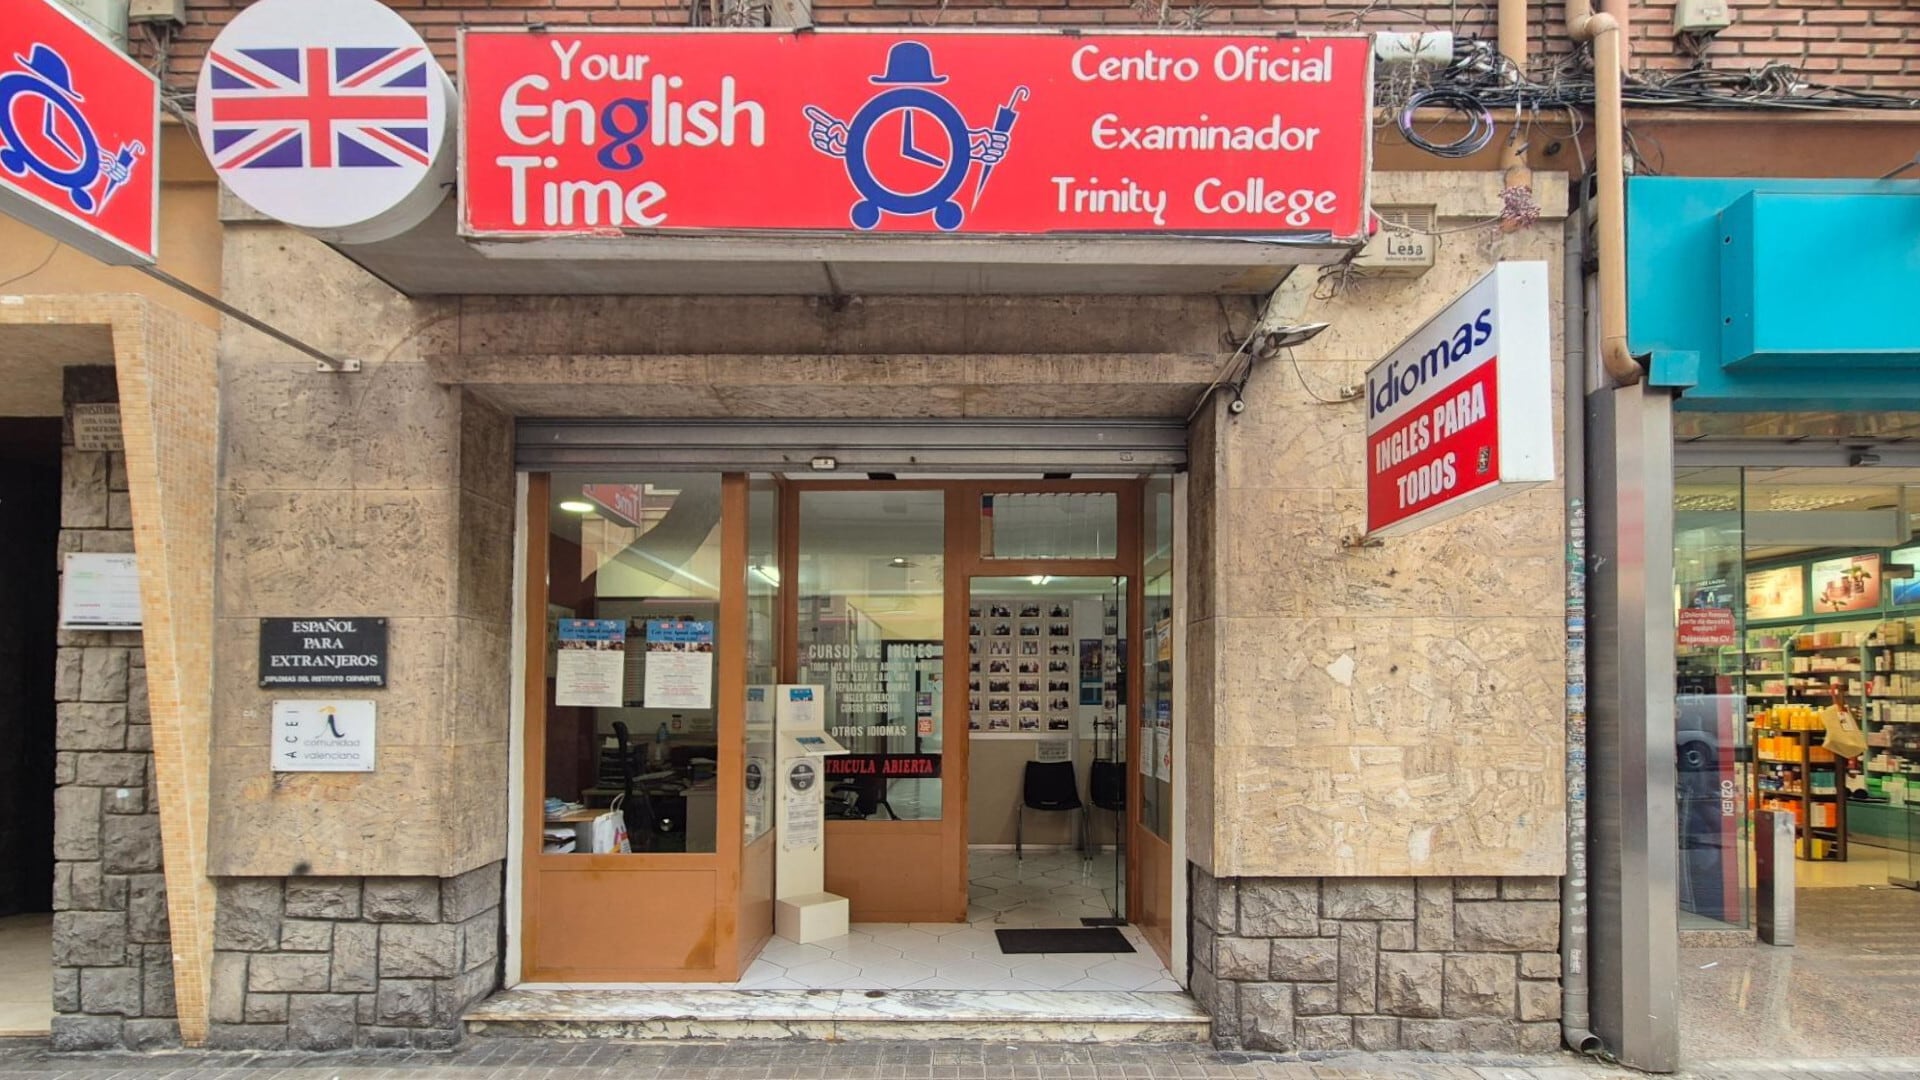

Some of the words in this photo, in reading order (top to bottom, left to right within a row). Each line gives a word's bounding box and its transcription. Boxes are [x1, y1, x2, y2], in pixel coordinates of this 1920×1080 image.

[551, 39, 650, 81] Your
[1071, 44, 1199, 82] Centro
[1213, 44, 1333, 82] Oficial
[500, 73, 765, 171] English
[1091, 113, 1320, 151] Examinador
[495, 155, 668, 226] Time
[1051, 176, 1167, 226] Trinity
[1193, 177, 1337, 227] College
[1369, 307, 1493, 420] Idiomas
[1375, 414, 1430, 474] INGLES
[1433, 380, 1487, 445] PARA
[1397, 452, 1457, 510] TODOS
[292, 618, 356, 633] ESPAÑOL
[303, 637, 344, 649] PARA
[270, 655, 378, 669] EXTRANJEROS
[808, 644, 858, 659] CURSOS
[865, 644, 882, 659] DE
[887, 643, 934, 659] INGLES
[303, 739, 360, 747] comunidad
[831, 725, 863, 737] OTROS
[867, 725, 907, 736] IDIOMAS
[303, 752, 360, 760] valenciana
[825, 759, 876, 774] TRICULA
[882, 759, 933, 774] ABIERTA
[1721, 779, 1734, 817] KENZO
